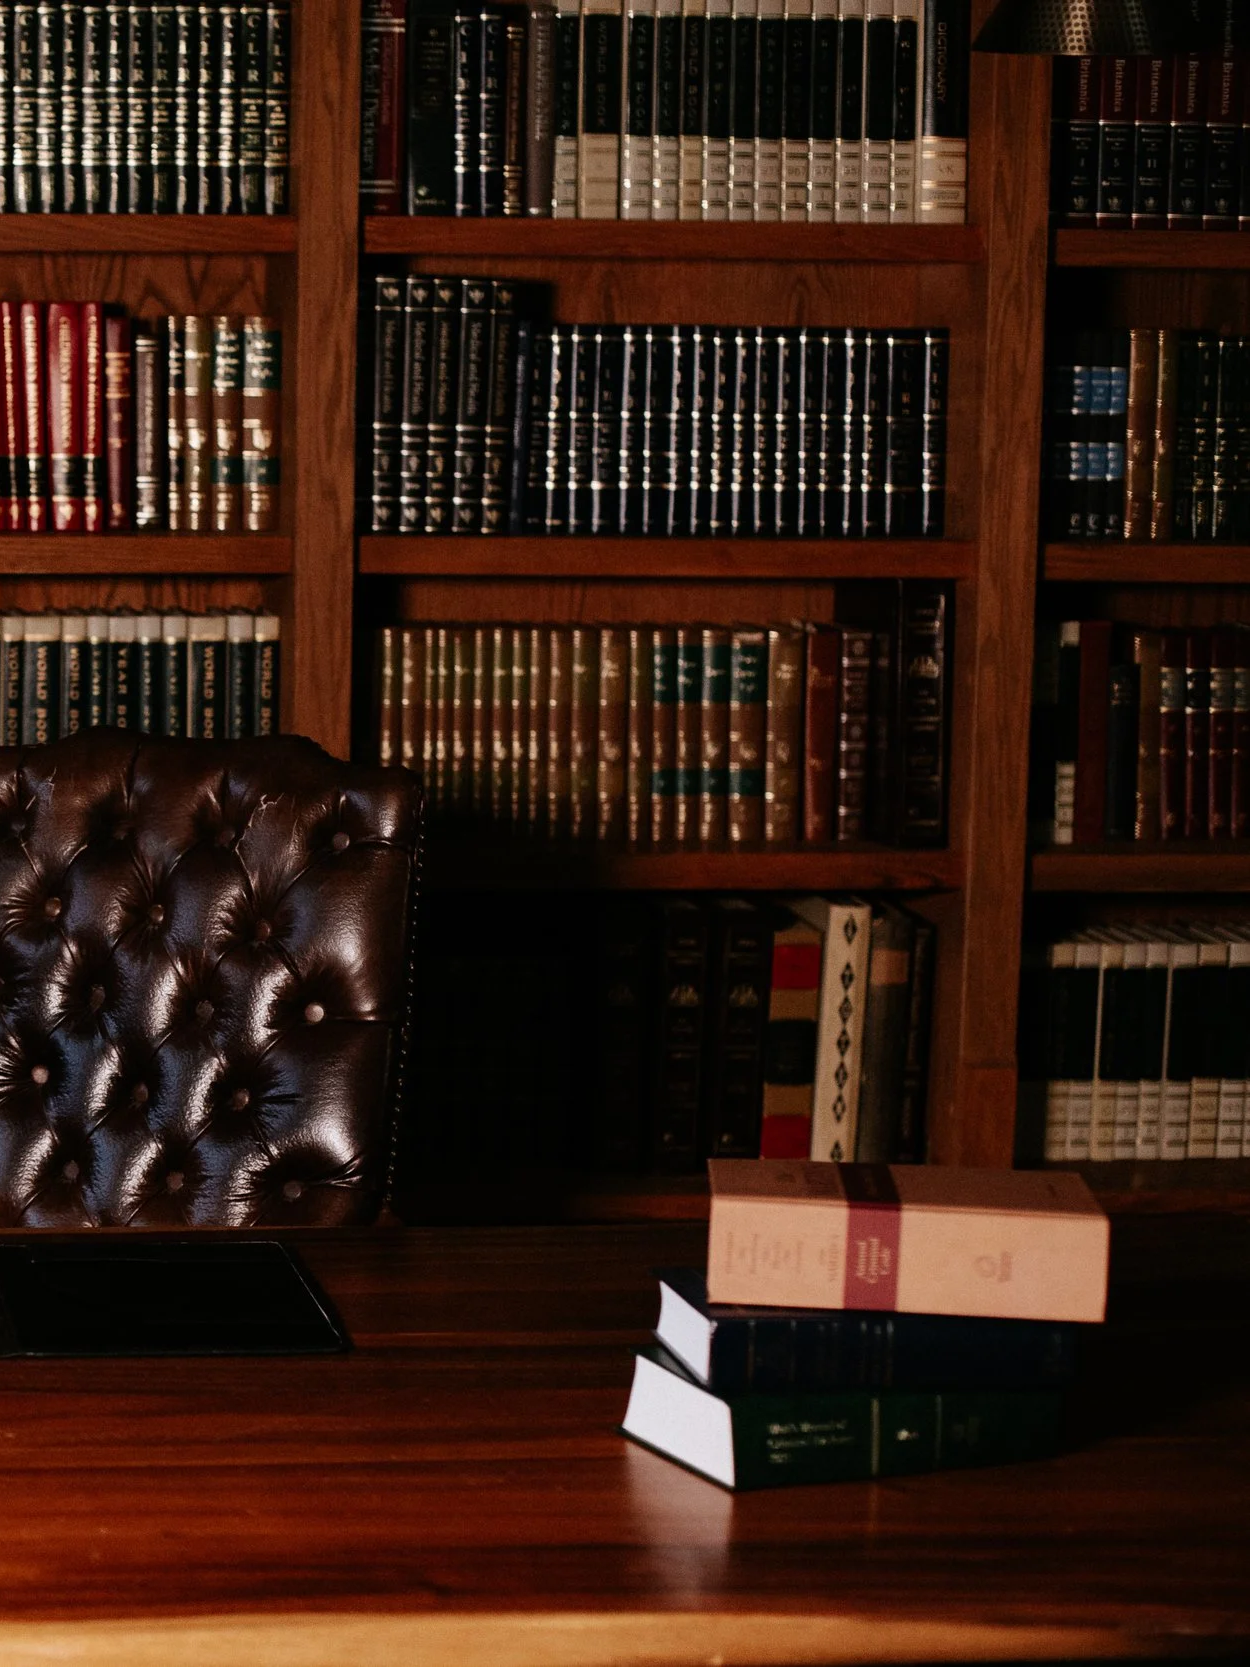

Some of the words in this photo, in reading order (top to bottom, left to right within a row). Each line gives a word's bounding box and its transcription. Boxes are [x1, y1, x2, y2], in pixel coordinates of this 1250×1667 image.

[597, 21, 607, 74] WORLD
[689, 24, 698, 76] WORLD
[936, 22, 947, 105] DICTIONARY
[596, 83, 606, 128] BOOK
[687, 84, 698, 129] BOOK
[1080, 58, 1091, 113] Britannica
[1114, 59, 1126, 113] Britannica
[1150, 60, 1162, 114] Britannica
[1187, 61, 1200, 115] Britannica
[1222, 62, 1234, 116] Britannica
[8, 647, 20, 700] WORLD
[36, 646, 48, 700] WORLD
[70, 646, 80, 700] WORLD
[118, 647, 128, 695] YEAR
[204, 646, 215, 700] WORLD
[262, 646, 273, 700] WORLD
[8, 705, 18, 747] BOO
[36, 704, 47, 745] BOO
[203, 706, 214, 737] BOO
[866, 1238, 880, 1284] Criminal
[880, 1248, 891, 1276] Code
